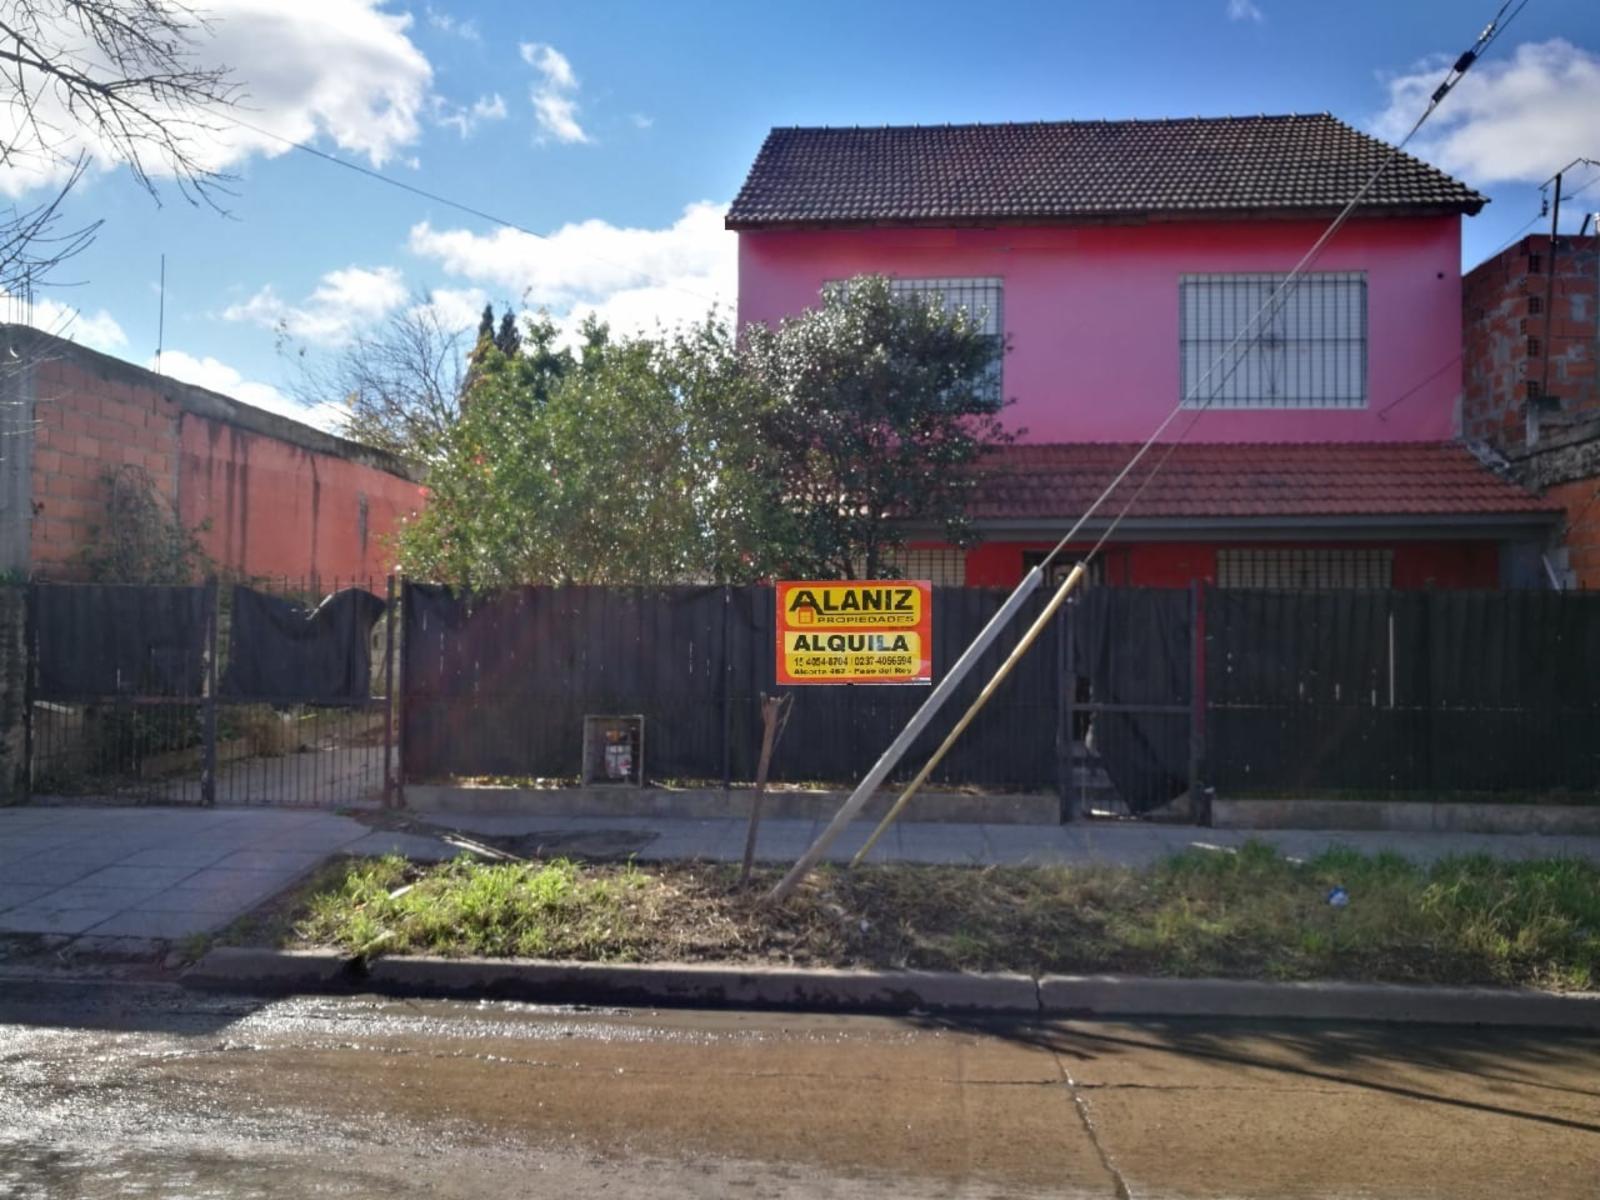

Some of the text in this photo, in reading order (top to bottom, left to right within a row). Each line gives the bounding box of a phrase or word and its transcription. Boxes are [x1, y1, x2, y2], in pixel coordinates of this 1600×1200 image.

[789, 589, 914, 615] ALANIZ
[817, 616, 914, 624] PROPIEDADES
[793, 634, 909, 652] ALQUILA
